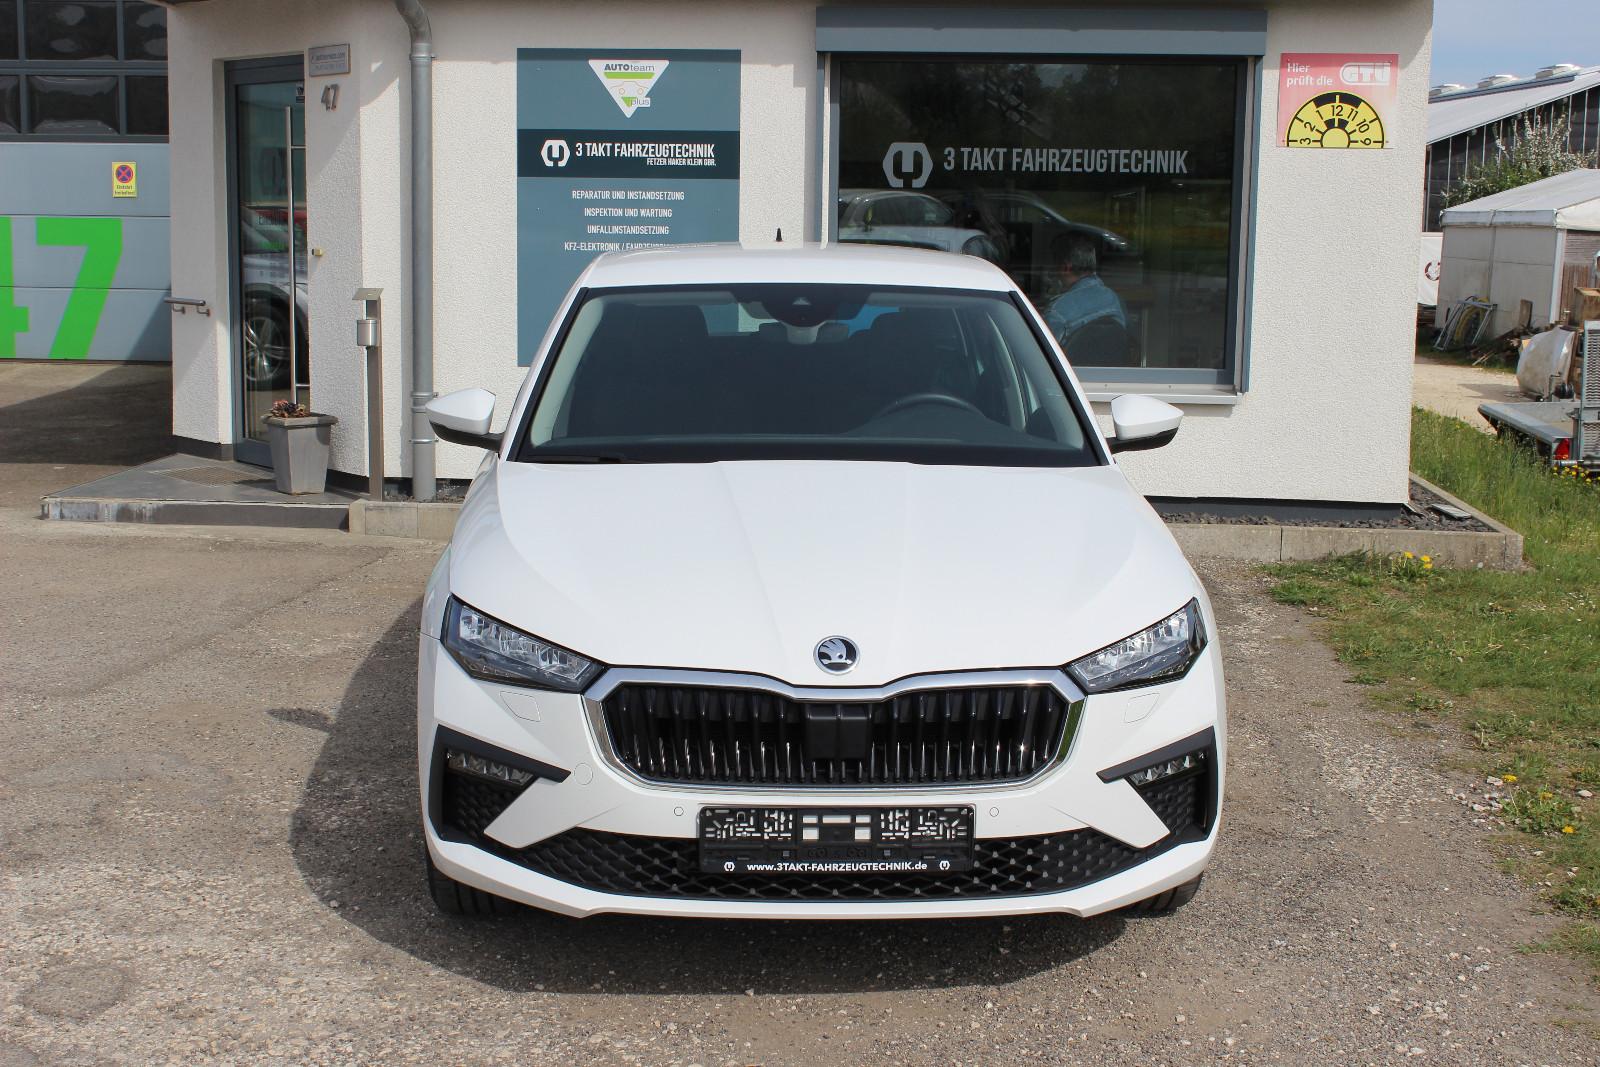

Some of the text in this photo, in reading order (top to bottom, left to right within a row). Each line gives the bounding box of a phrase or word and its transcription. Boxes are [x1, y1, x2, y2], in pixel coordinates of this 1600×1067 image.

[1287, 63, 1310, 73] Hier
[1287, 75, 1333, 88] prüft die
[321, 84, 339, 112] 47
[631, 98, 650, 107] plus
[1316, 110, 1323, 120] 1
[1331, 105, 1343, 116] 12
[1347, 108, 1359, 121] 11
[1304, 121, 1316, 132] 2
[1357, 119, 1369, 133] 10
[1299, 137, 1311, 145] 3
[575, 143, 715, 158] 3 TAKT FAHRZEUGTECHNIK
[647, 158, 667, 166] FETZER
[687, 158, 703, 166] KLEIN
[943, 147, 1188, 174] 3 TAKT FAHRZEUGTECHNIK
[572, 190, 685, 201] REPARATUR UND INSTANDSETZUNG
[584, 207, 673, 218] INSPEKTION UND WARTUNG
[587, 225, 670, 235] UNFALLINSTANDSETZUNG
[564, 242, 620, 252] KFZ-ELEKTRONIK
[747, 861, 928, 872] www.3TAKT-FAHRZEUGTECHNIK.de
